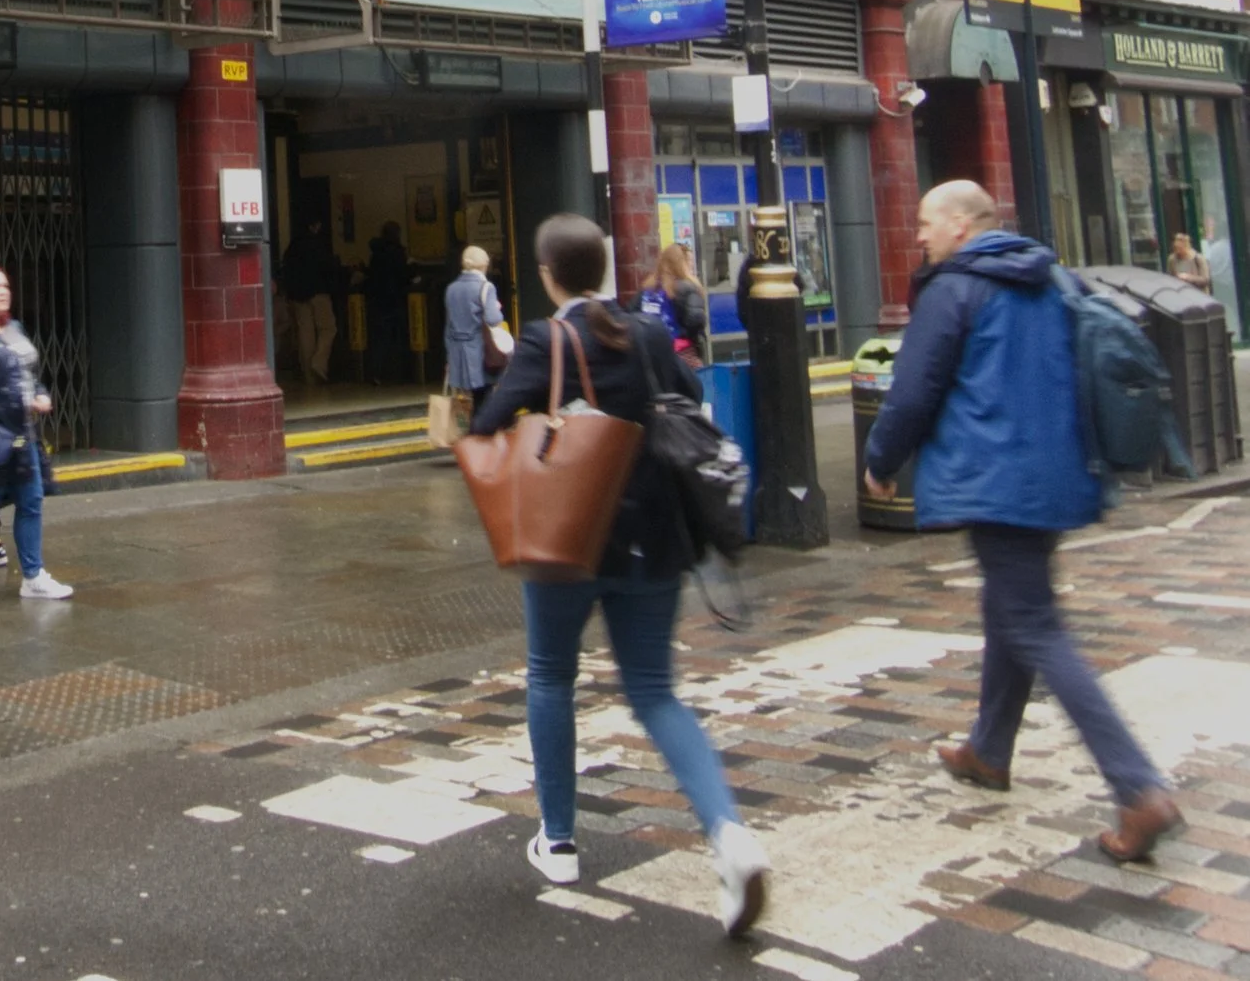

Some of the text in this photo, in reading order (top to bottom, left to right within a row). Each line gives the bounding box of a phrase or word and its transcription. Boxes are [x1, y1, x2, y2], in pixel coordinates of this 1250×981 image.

[1114, 33, 1224, 72] HOLLAND & BARRETT
[224, 65, 245, 77] RVP
[232, 202, 260, 216] LFB
